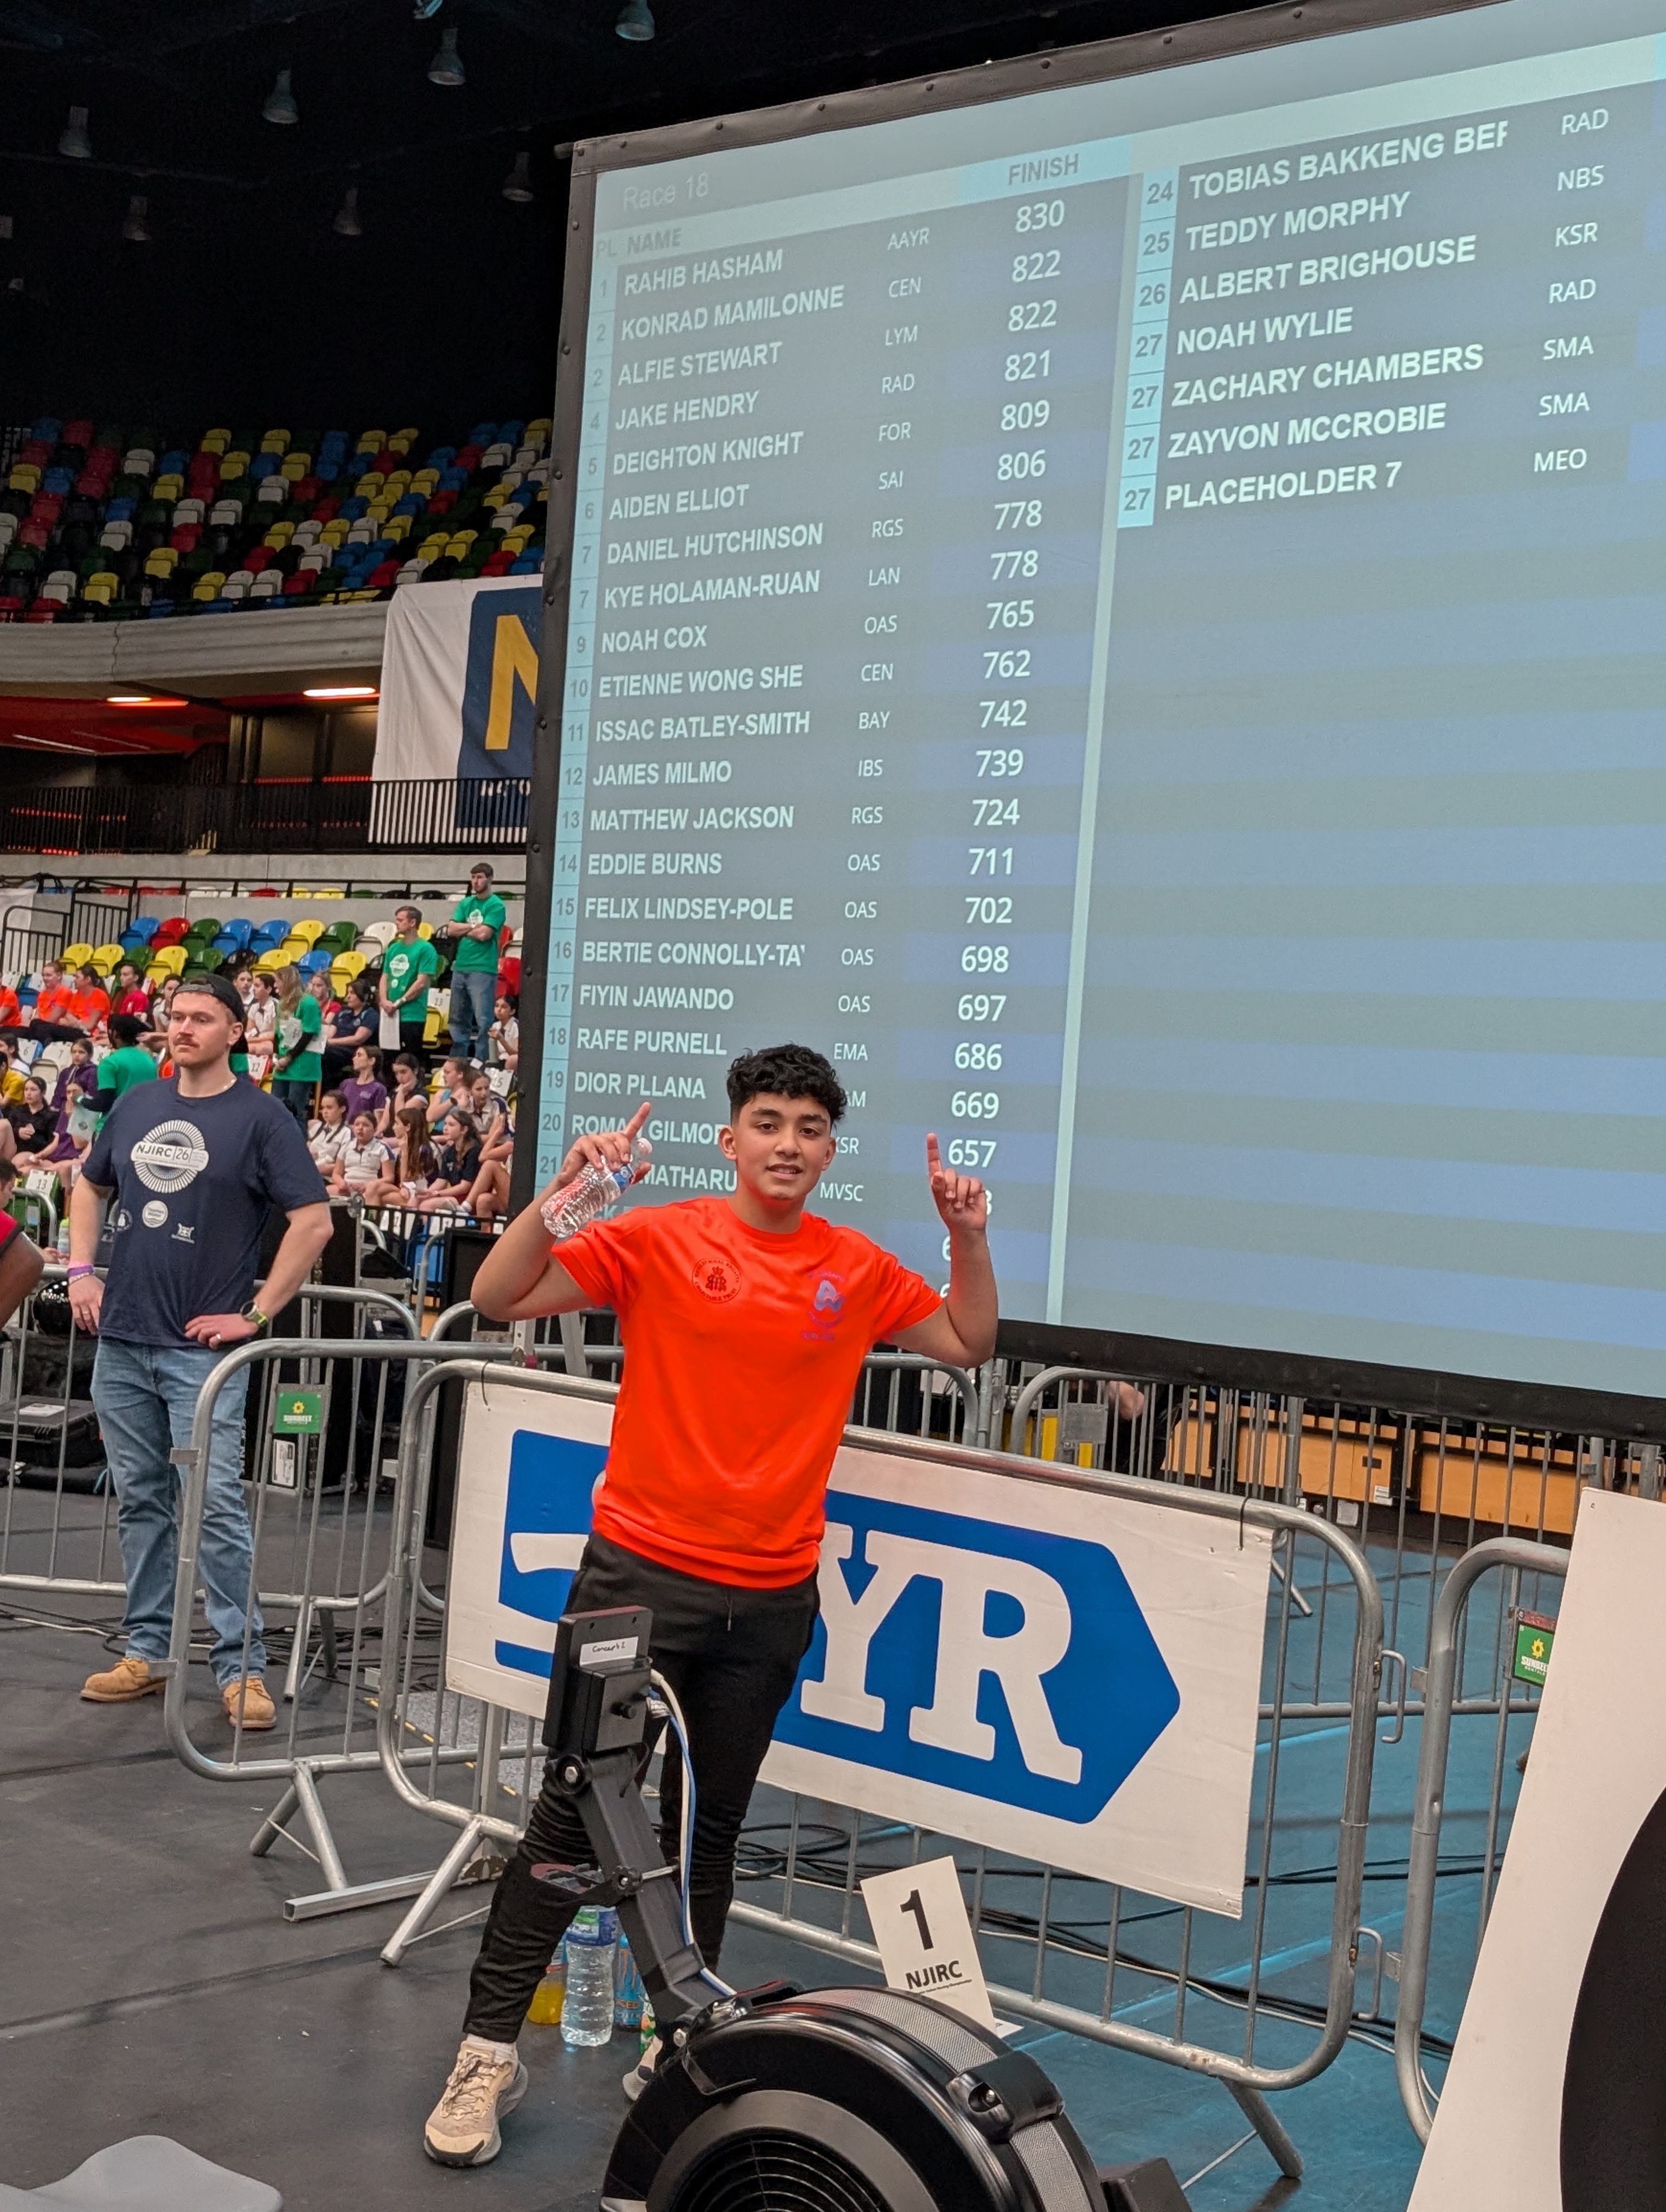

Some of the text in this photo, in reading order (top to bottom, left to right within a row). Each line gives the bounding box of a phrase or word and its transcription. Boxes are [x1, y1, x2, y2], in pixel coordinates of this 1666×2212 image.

[1008, 153, 1079, 185] FINISH
[1146, 181, 1174, 204] 24
[1189, 159, 1290, 198] TOBIAS
[1299, 132, 1444, 181] BAKKENG
[1561, 109, 1609, 135] RAD
[623, 173, 709, 211] Race 18
[1143, 165, 1605, 256] 25 TEDDY MORPHY NBS
[625, 266, 685, 295] RAHIB
[693, 249, 783, 283] HASHAM
[887, 228, 930, 250] AAYR
[1015, 200, 1065, 233] 830
[627, 227, 682, 254] NAME
[1138, 222, 1598, 307] 26 ALBERT BRIGHOUSE KSR
[621, 308, 707, 340] KONRAD
[714, 285, 844, 325] MAMILONNE
[888, 277, 921, 298] CEN
[1011, 249, 1061, 282] 822
[1135, 279, 1596, 358] 27 NOAH WYLIE RAD
[618, 357, 674, 386] ALFIE
[681, 341, 782, 376] STEWART
[885, 325, 918, 345] LYM
[1008, 299, 1058, 331] 822
[616, 403, 667, 430] JAKE
[674, 390, 759, 423] HENDRY
[882, 374, 915, 394] RAD
[1004, 350, 1051, 382] 821
[1131, 336, 1594, 409] 27 ZACHARY CHAMBERS SMA
[588, 400, 1050, 475] 5 DEIGHTON KNIGHT FOR 809
[1127, 393, 1590, 460] 27 ZAYVON MCCROBIE SMA
[585, 449, 1046, 520] 6 AIDEN ELLIOT SAI 806
[1124, 448, 1587, 511] 27 PLACEHOLDER 7 MEO
[581, 500, 1042, 564] 7 DANIEL HUTCHINSON RGS 778
[580, 550, 1039, 609] 7 KYE HOLAMAN-RUAN LAN 778
[578, 600, 1034, 653] 9 NOAH COX OAS 765
[571, 650, 1031, 698] 10 ETIENNE WONG SHE CEN 762
[568, 699, 1028, 742] 11 ISSAC BATLEY-SMITH BAY 742
[565, 749, 1024, 786] 12 JAMES MILMO IBS 739
[562, 799, 1020, 831] 13 MATTHEW JACKSON RGS 724
[559, 847, 1014, 876] 14 EDDIE BURNS OAS 711
[556, 897, 1013, 924] 15 FELIX LINDSEY-POLE OAS 702
[554, 941, 1009, 973] 16 BERTIE CONNOLLY-TA OAS 698
[552, 985, 1007, 1022] 17 FIYIN JAWANDO OAS 697
[549, 1027, 1003, 1071] 18 RAFE PURNELL EMA 686
[546, 1071, 564, 1088] 19
[574, 1071, 622, 1095] DIOR
[626, 1074, 706, 1099] PLLANA
[951, 1091, 999, 1118] 669
[137, 1144, 172, 1158] NJIRC
[176, 1148, 189, 1161] 26
[543, 1114, 561, 1131] 20
[948, 1139, 997, 1168] 657
[540, 1156, 557, 1174] 21
[819, 1182, 863, 1202] MVSC
[900, 1888, 934, 1951] 1
[905, 1960, 963, 1990] NJIRC
